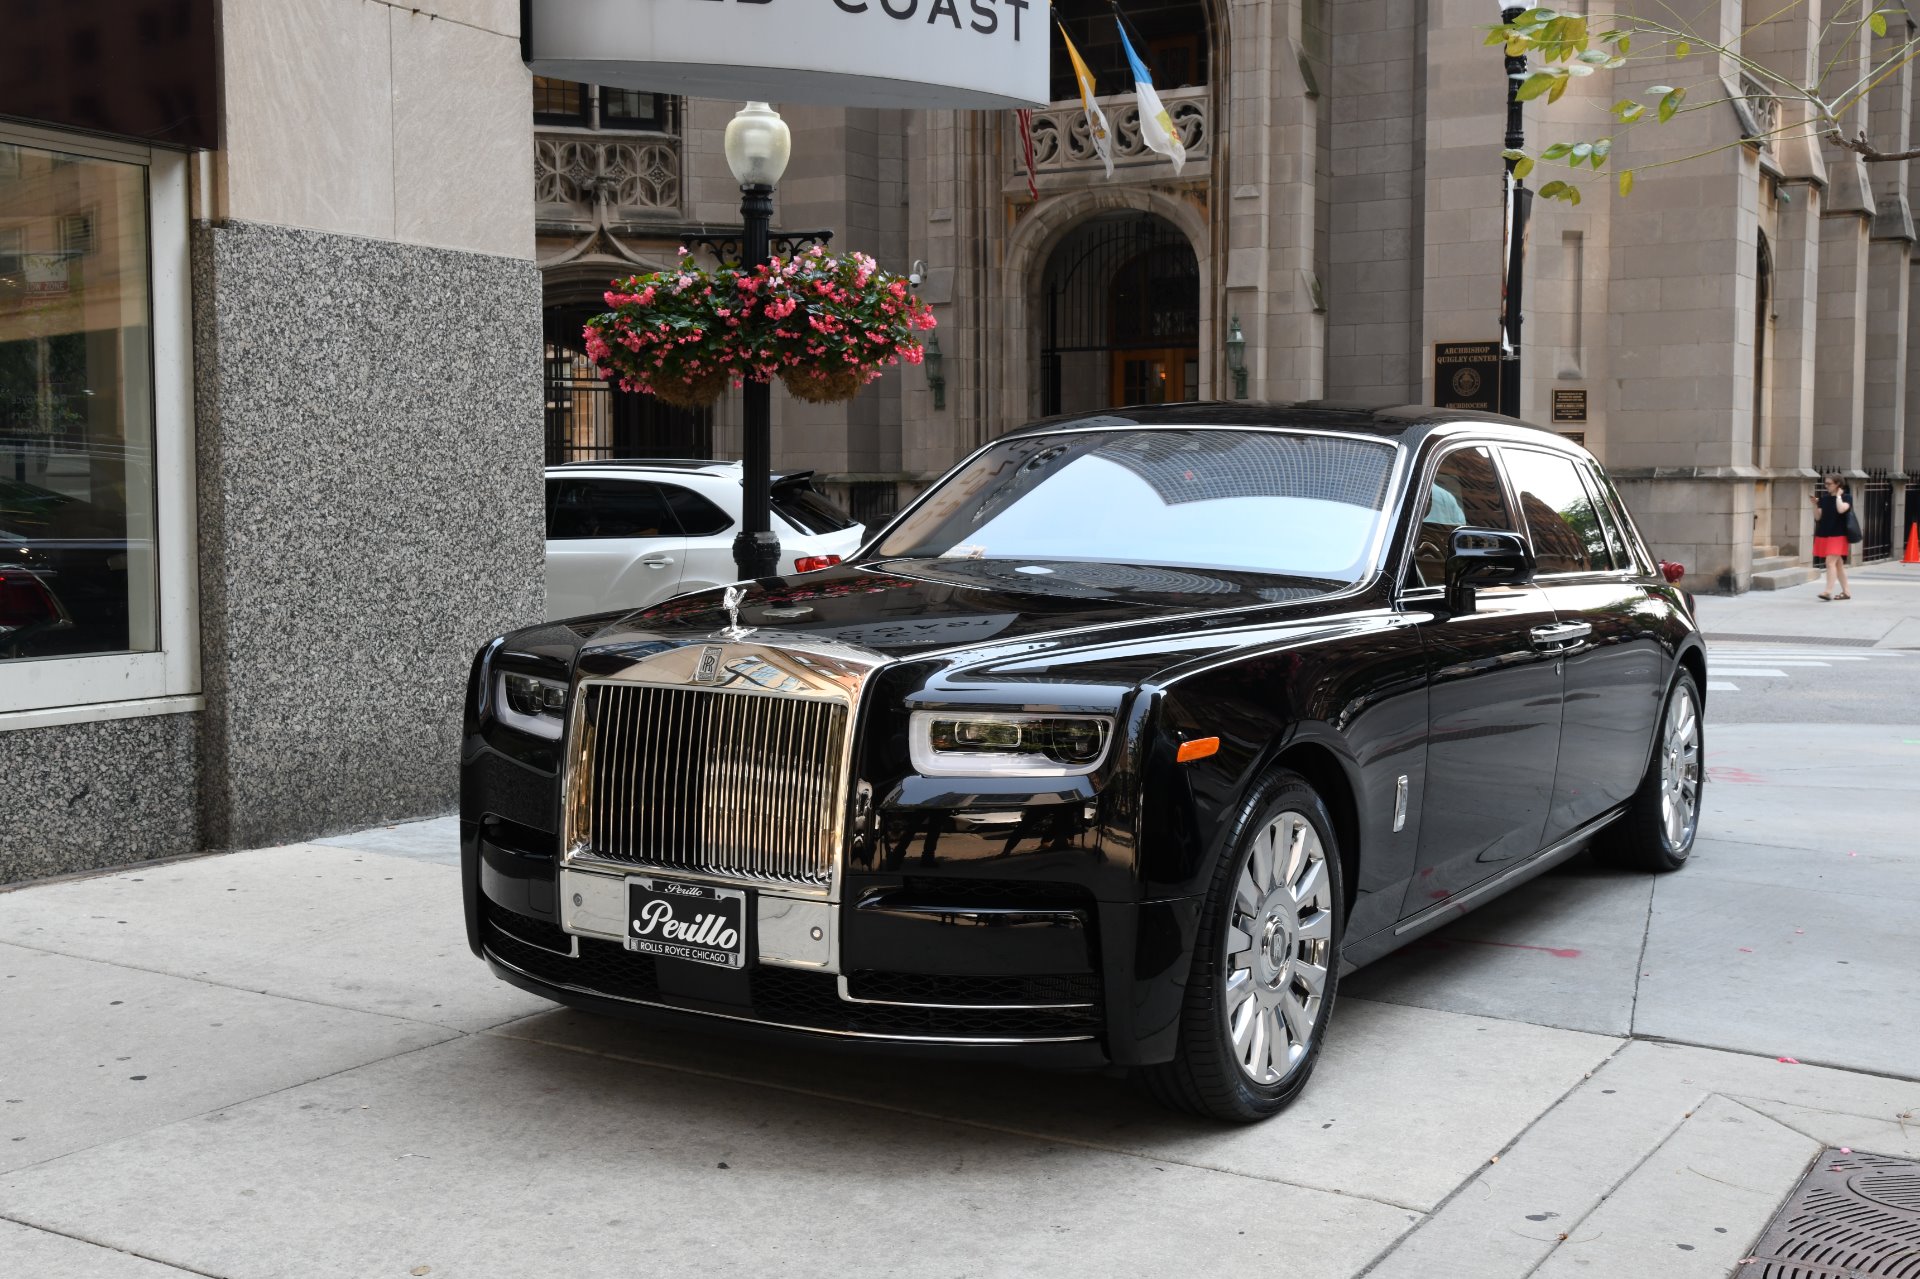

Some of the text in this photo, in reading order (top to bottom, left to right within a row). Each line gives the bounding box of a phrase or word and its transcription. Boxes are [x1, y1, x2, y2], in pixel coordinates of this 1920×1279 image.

[1445, 346, 1490, 354] ARCHBISHOP
[1437, 356, 1468, 364] QUIGLEY
[664, 883, 703, 896] Perillo
[632, 899, 738, 949] Perillo
[640, 941, 726, 963] ROLLS ROYCE CHICAGO
